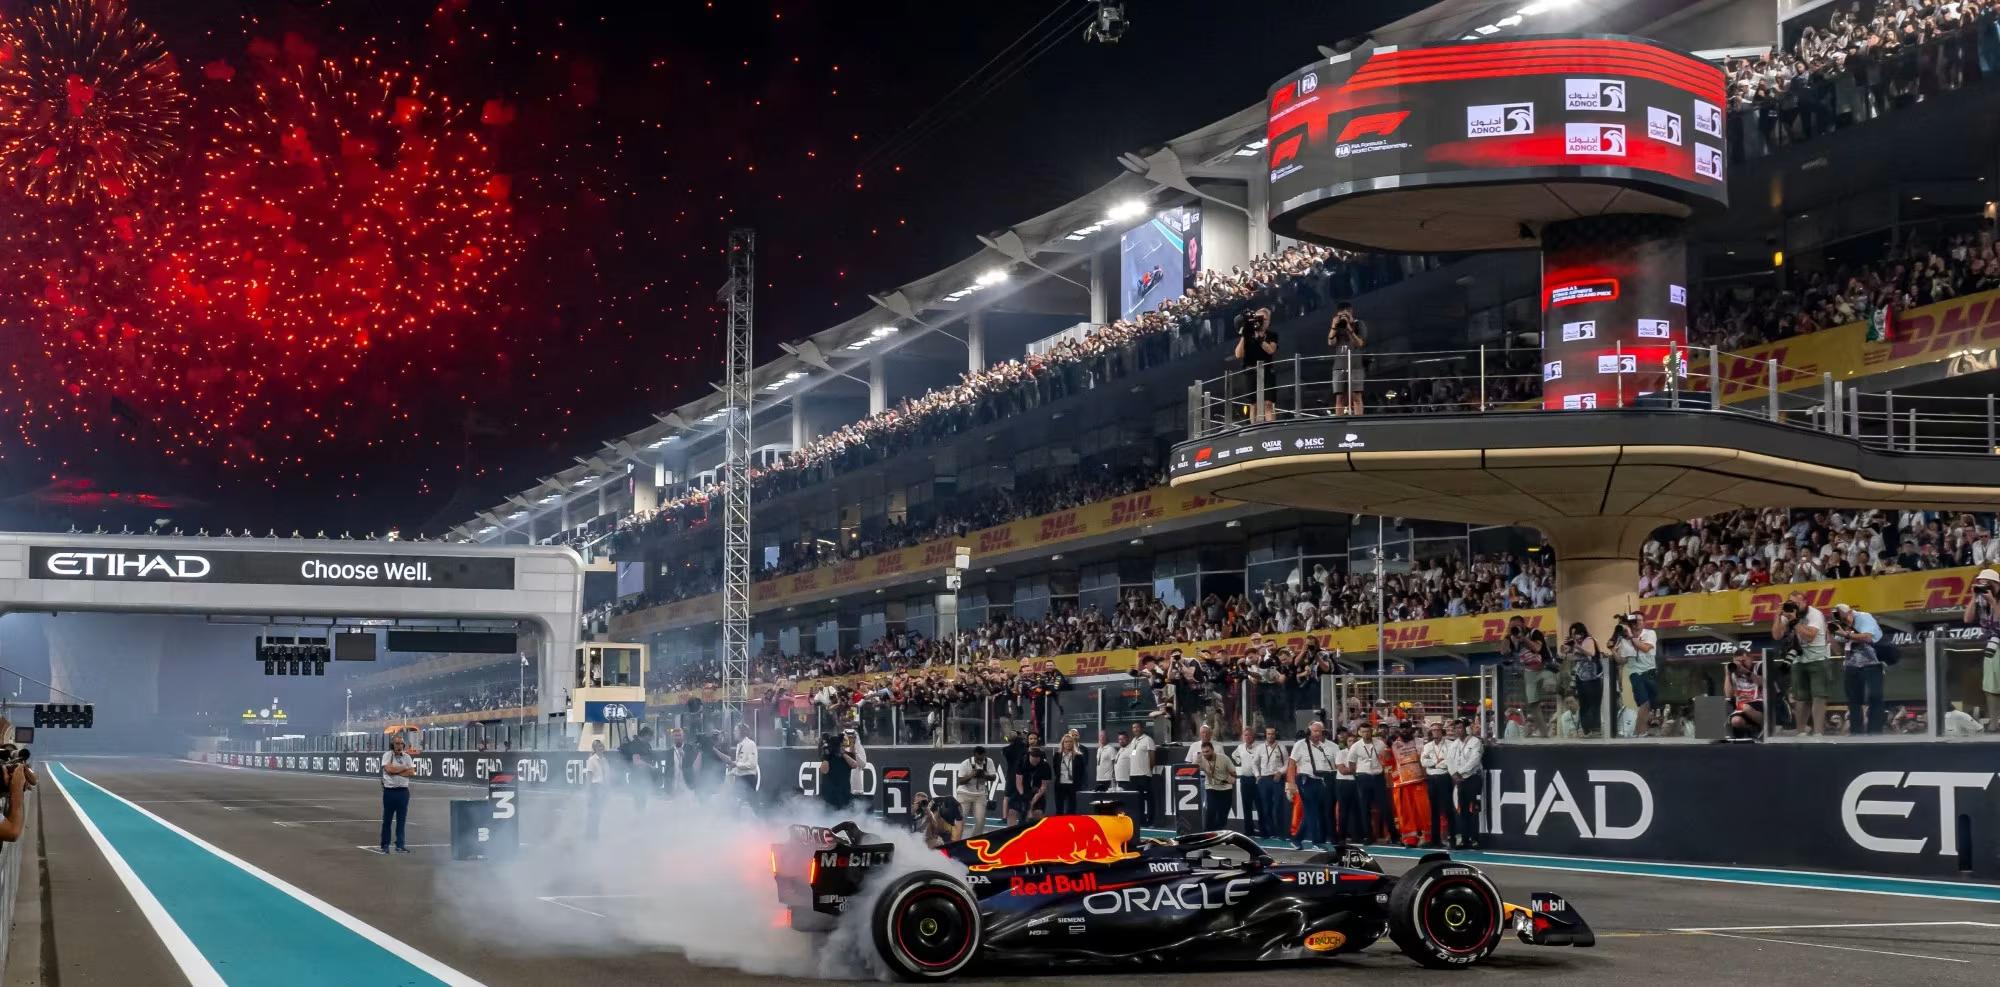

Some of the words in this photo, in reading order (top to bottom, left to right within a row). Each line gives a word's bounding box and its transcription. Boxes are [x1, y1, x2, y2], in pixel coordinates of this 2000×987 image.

[1569, 100, 1598, 108] ADNOC
[1470, 126, 1501, 135] ADNOC
[1569, 144, 1598, 152] ADNOC
[1262, 440, 1282, 449] QATAR
[1304, 438, 1325, 446] MSC
[1110, 495, 1154, 524] DHL
[1040, 513, 1078, 540] DHL
[47, 552, 210, 577] ETIHAD
[301, 559, 379, 579] Choose
[384, 562, 432, 581] Well.
[1380, 625, 1434, 652] DHL
[1684, 643, 1719, 656] SERGIO
[1076, 656, 1110, 677] DHL
[604, 704, 626, 718] FIA
[441, 758, 464, 778] ETIHAD
[517, 759, 548, 782] ETIHAD
[492, 791, 515, 819] 3
[887, 787, 907, 814] 1
[1178, 784, 1199, 811] 2
[1479, 769, 1654, 840] IHAD
[1841, 771, 2000, 856] ET
[478, 827, 489, 842] 3
[820, 852, 871, 868] Mobil
[1149, 862, 1179, 873] ROKT
[1010, 873, 1052, 896] Red
[1054, 871, 1097, 893] Bull
[1298, 866, 1339, 885] BYBIT
[1083, 878, 1251, 915] ORACLE
[1532, 899, 1565, 912] Mobil
